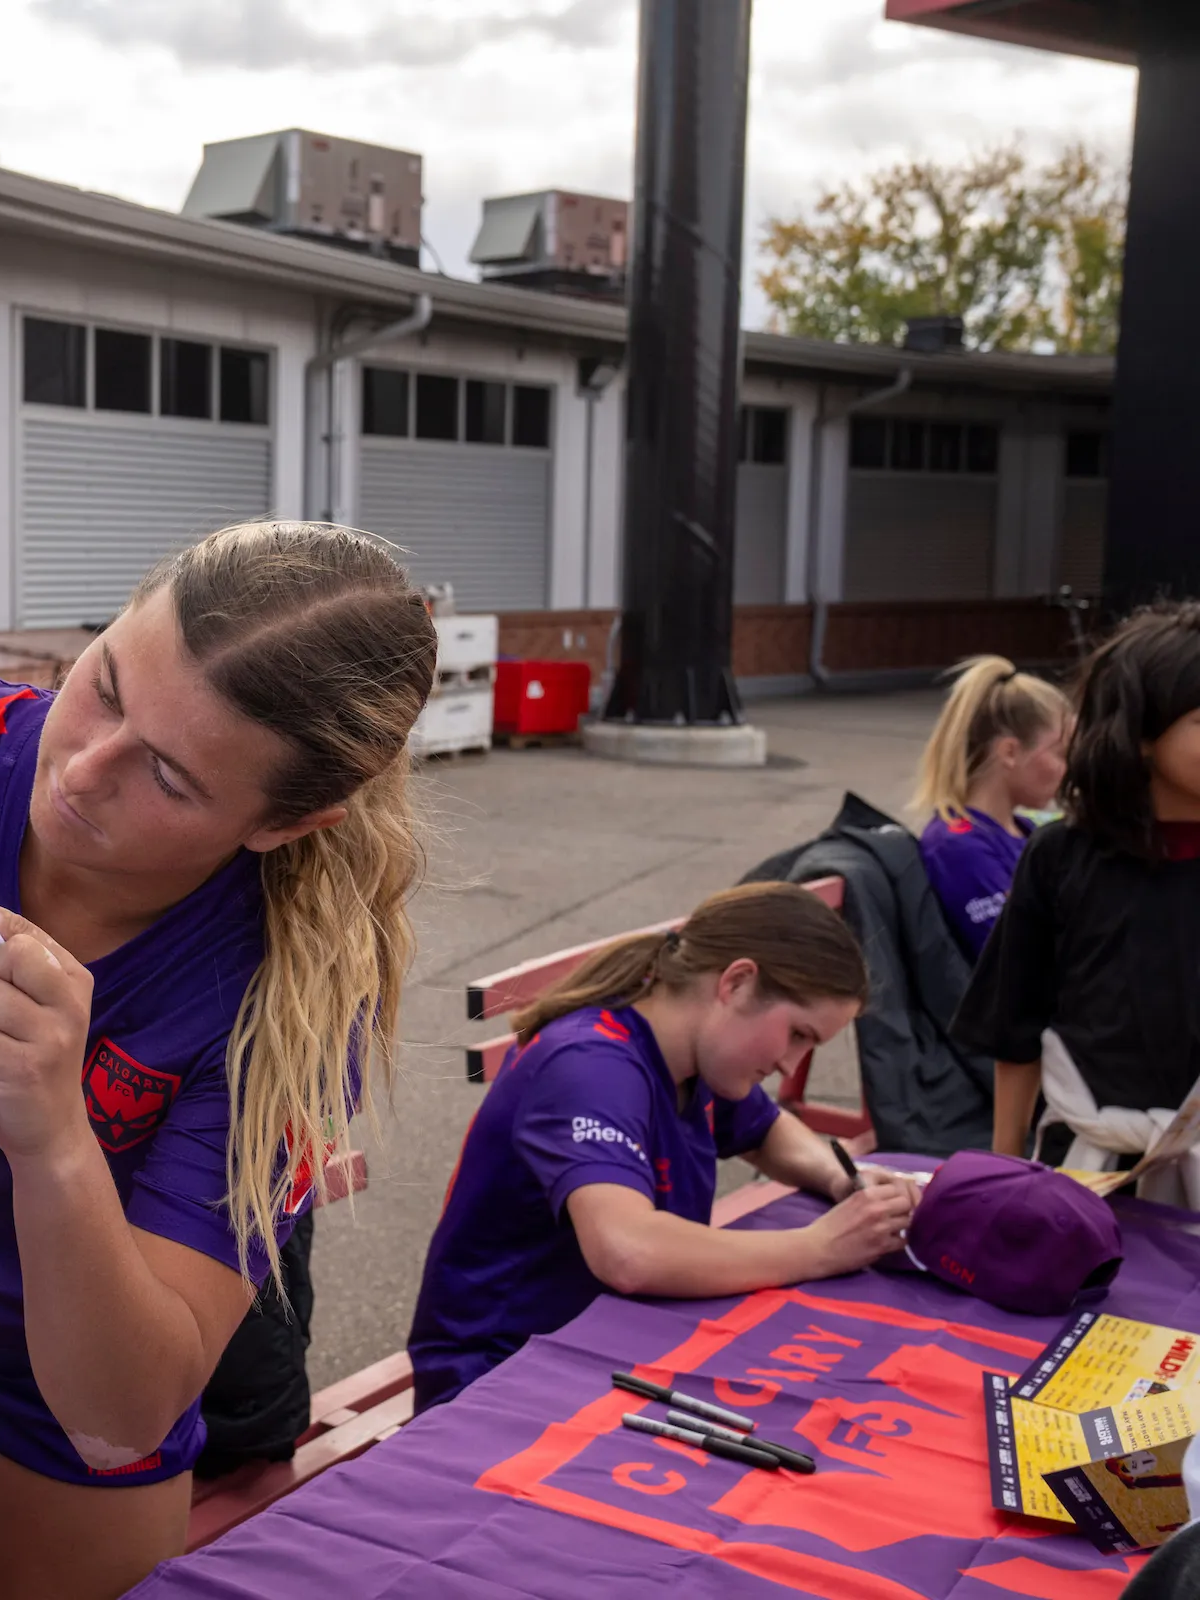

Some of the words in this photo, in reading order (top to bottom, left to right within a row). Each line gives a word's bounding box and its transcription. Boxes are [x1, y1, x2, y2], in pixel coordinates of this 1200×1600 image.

[99, 1051, 167, 1092] CALGARY
[114, 1083, 131, 1097] FC
[1122, 1410, 1130, 1423] MAY
[1135, 1408, 1144, 1421] MAY
[826, 1412, 913, 1458] FC
